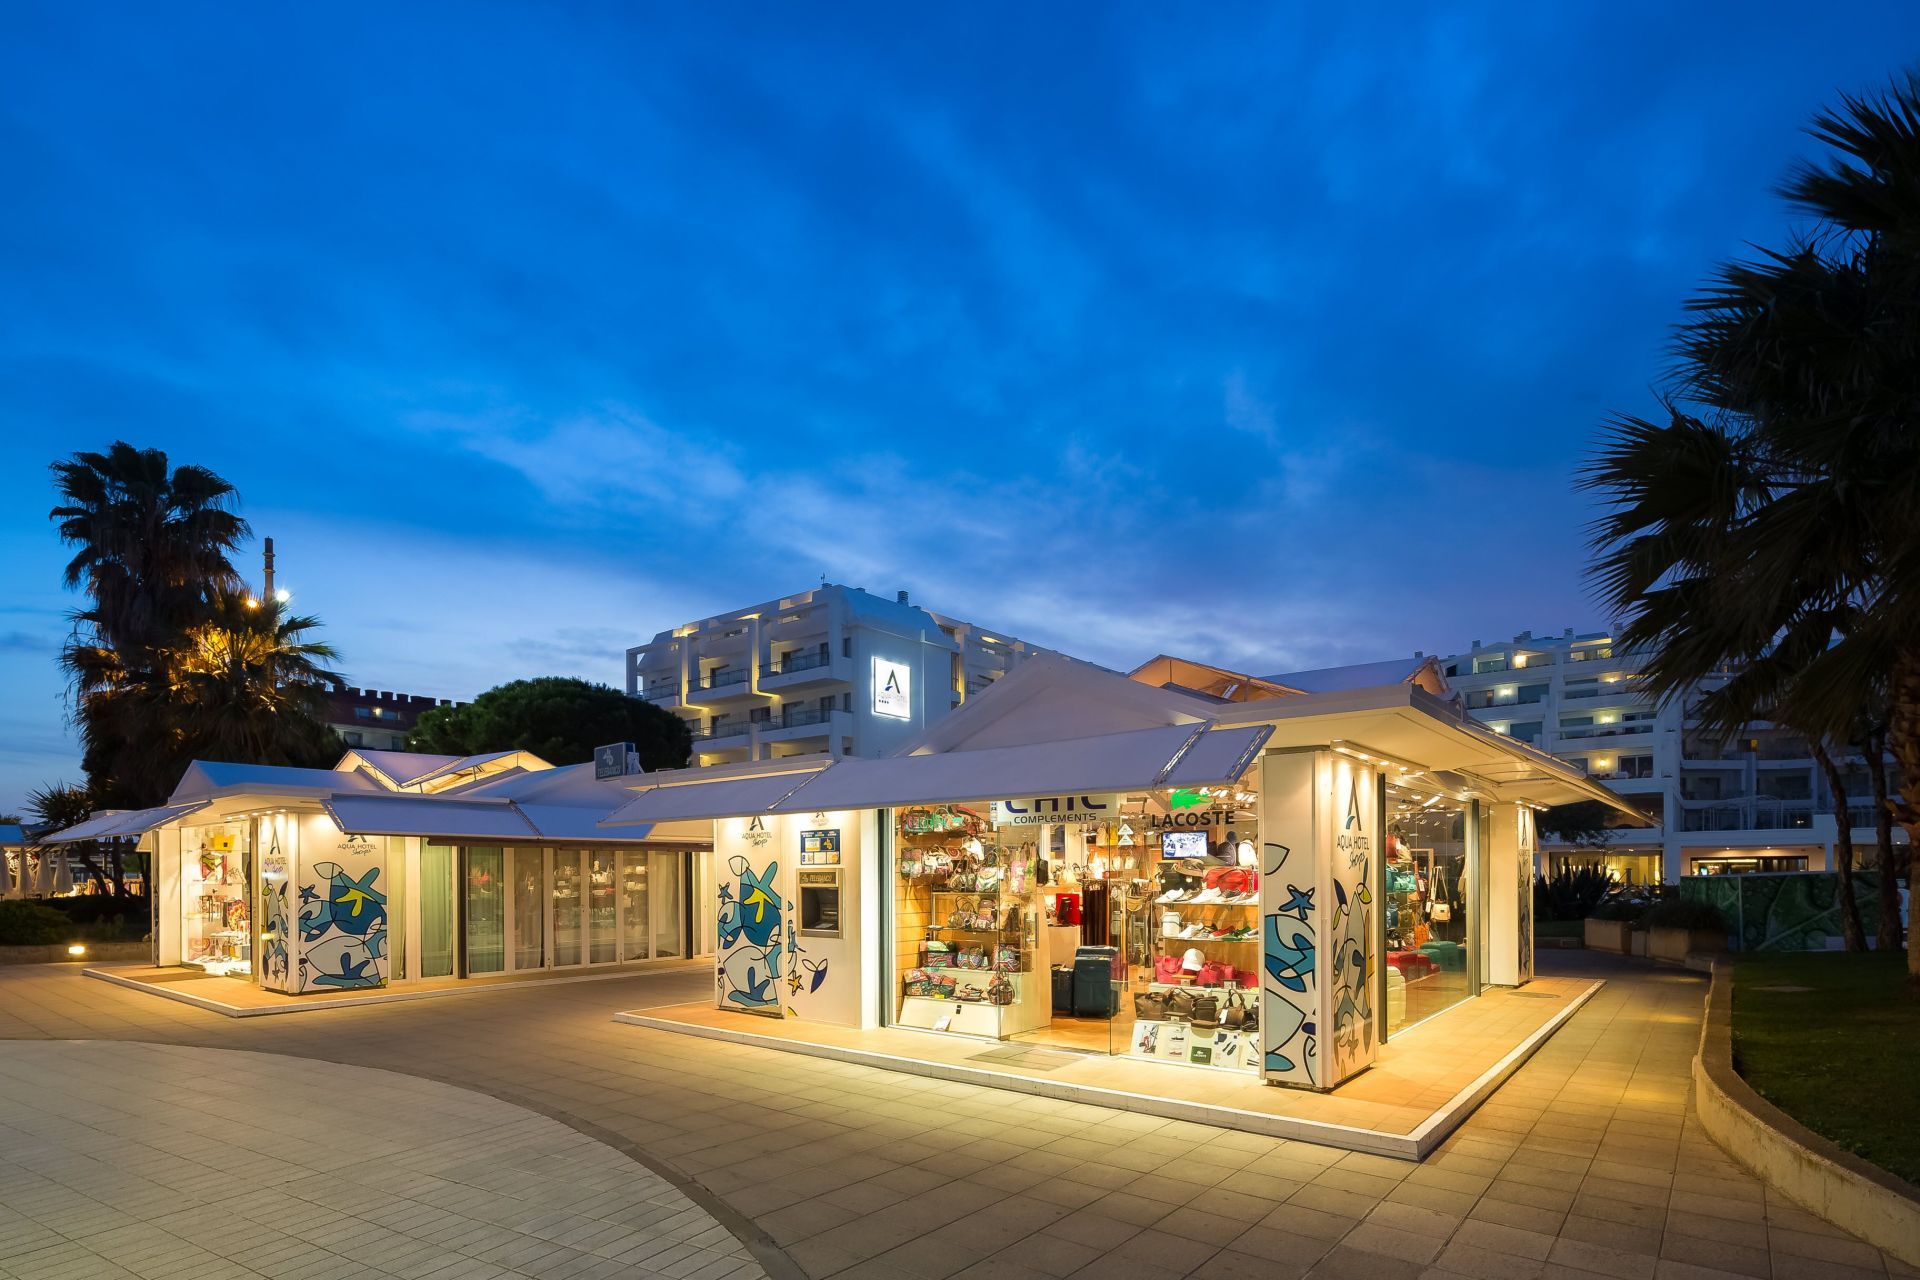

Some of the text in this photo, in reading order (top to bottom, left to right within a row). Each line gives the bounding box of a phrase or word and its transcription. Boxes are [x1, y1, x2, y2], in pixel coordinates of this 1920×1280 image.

[1013, 812, 1097, 824] COMPLEMENTS
[1151, 811, 1236, 828] LACOSTE
[742, 831, 772, 840] AQUA HOTEL
[1336, 834, 1370, 851] AQUA HOTEL
[809, 874, 833, 882] TELEBANCO
